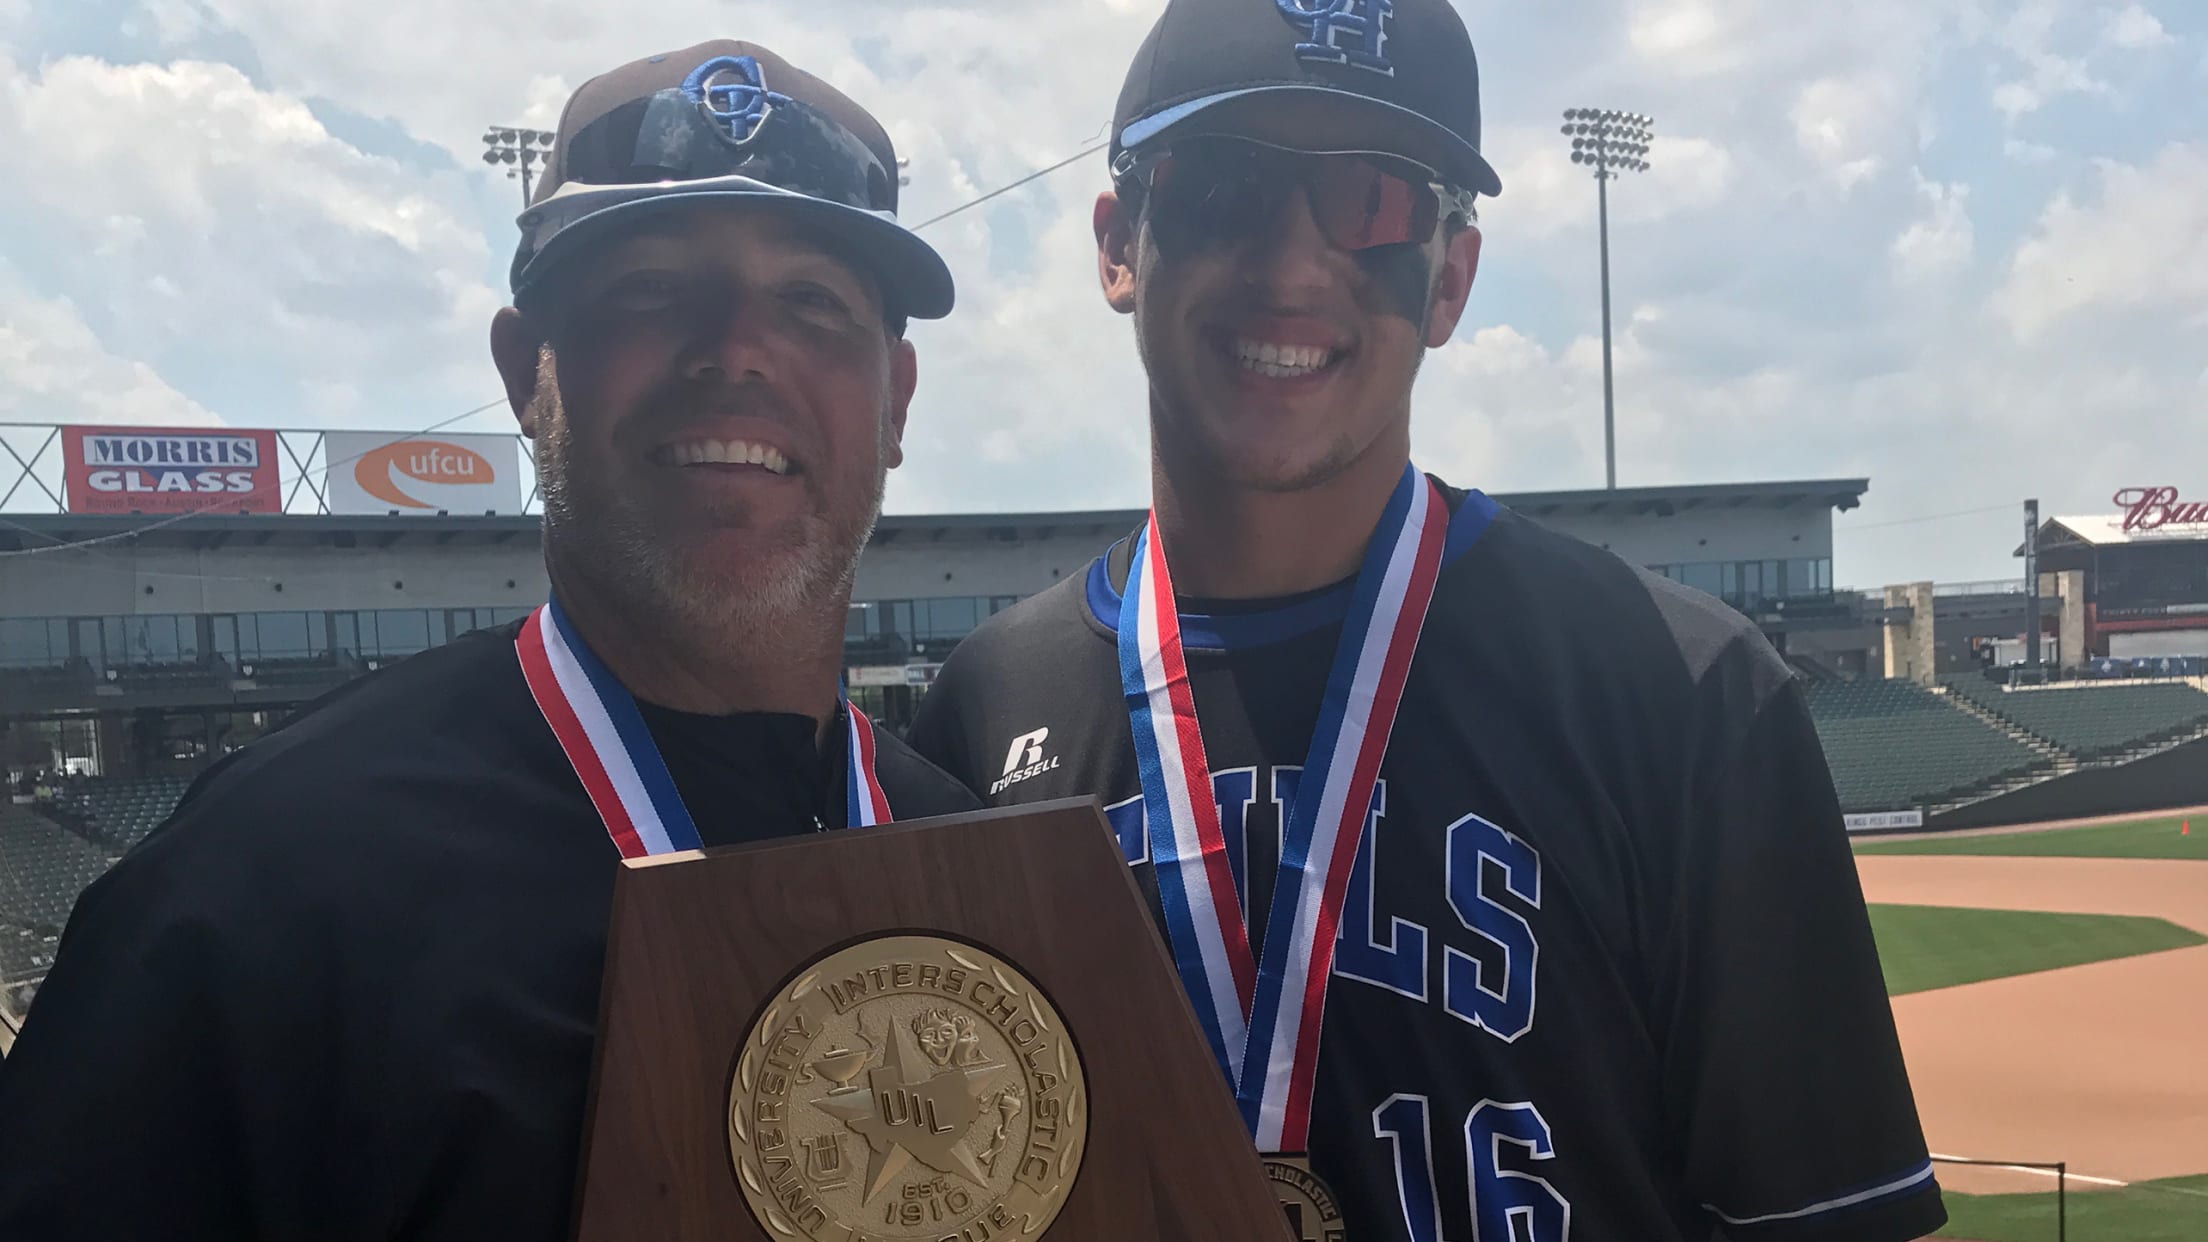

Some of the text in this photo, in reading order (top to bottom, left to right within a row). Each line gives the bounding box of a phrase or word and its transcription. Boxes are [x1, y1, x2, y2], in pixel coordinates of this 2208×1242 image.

[93, 438, 253, 464] MORRIS
[410, 448, 474, 476] ufcu
[87, 470, 255, 493] GLASS
[990, 755, 1060, 795] RUSSELL
[828, 962, 1061, 1181] INTERSCHOLASTIC
[757, 1015, 828, 1234] UNIVERSITY
[881, 1089, 955, 1136] UIL
[1372, 1093, 1571, 1242] 16
[885, 1186, 973, 1226] 1910
[902, 1176, 950, 1200] EST.
